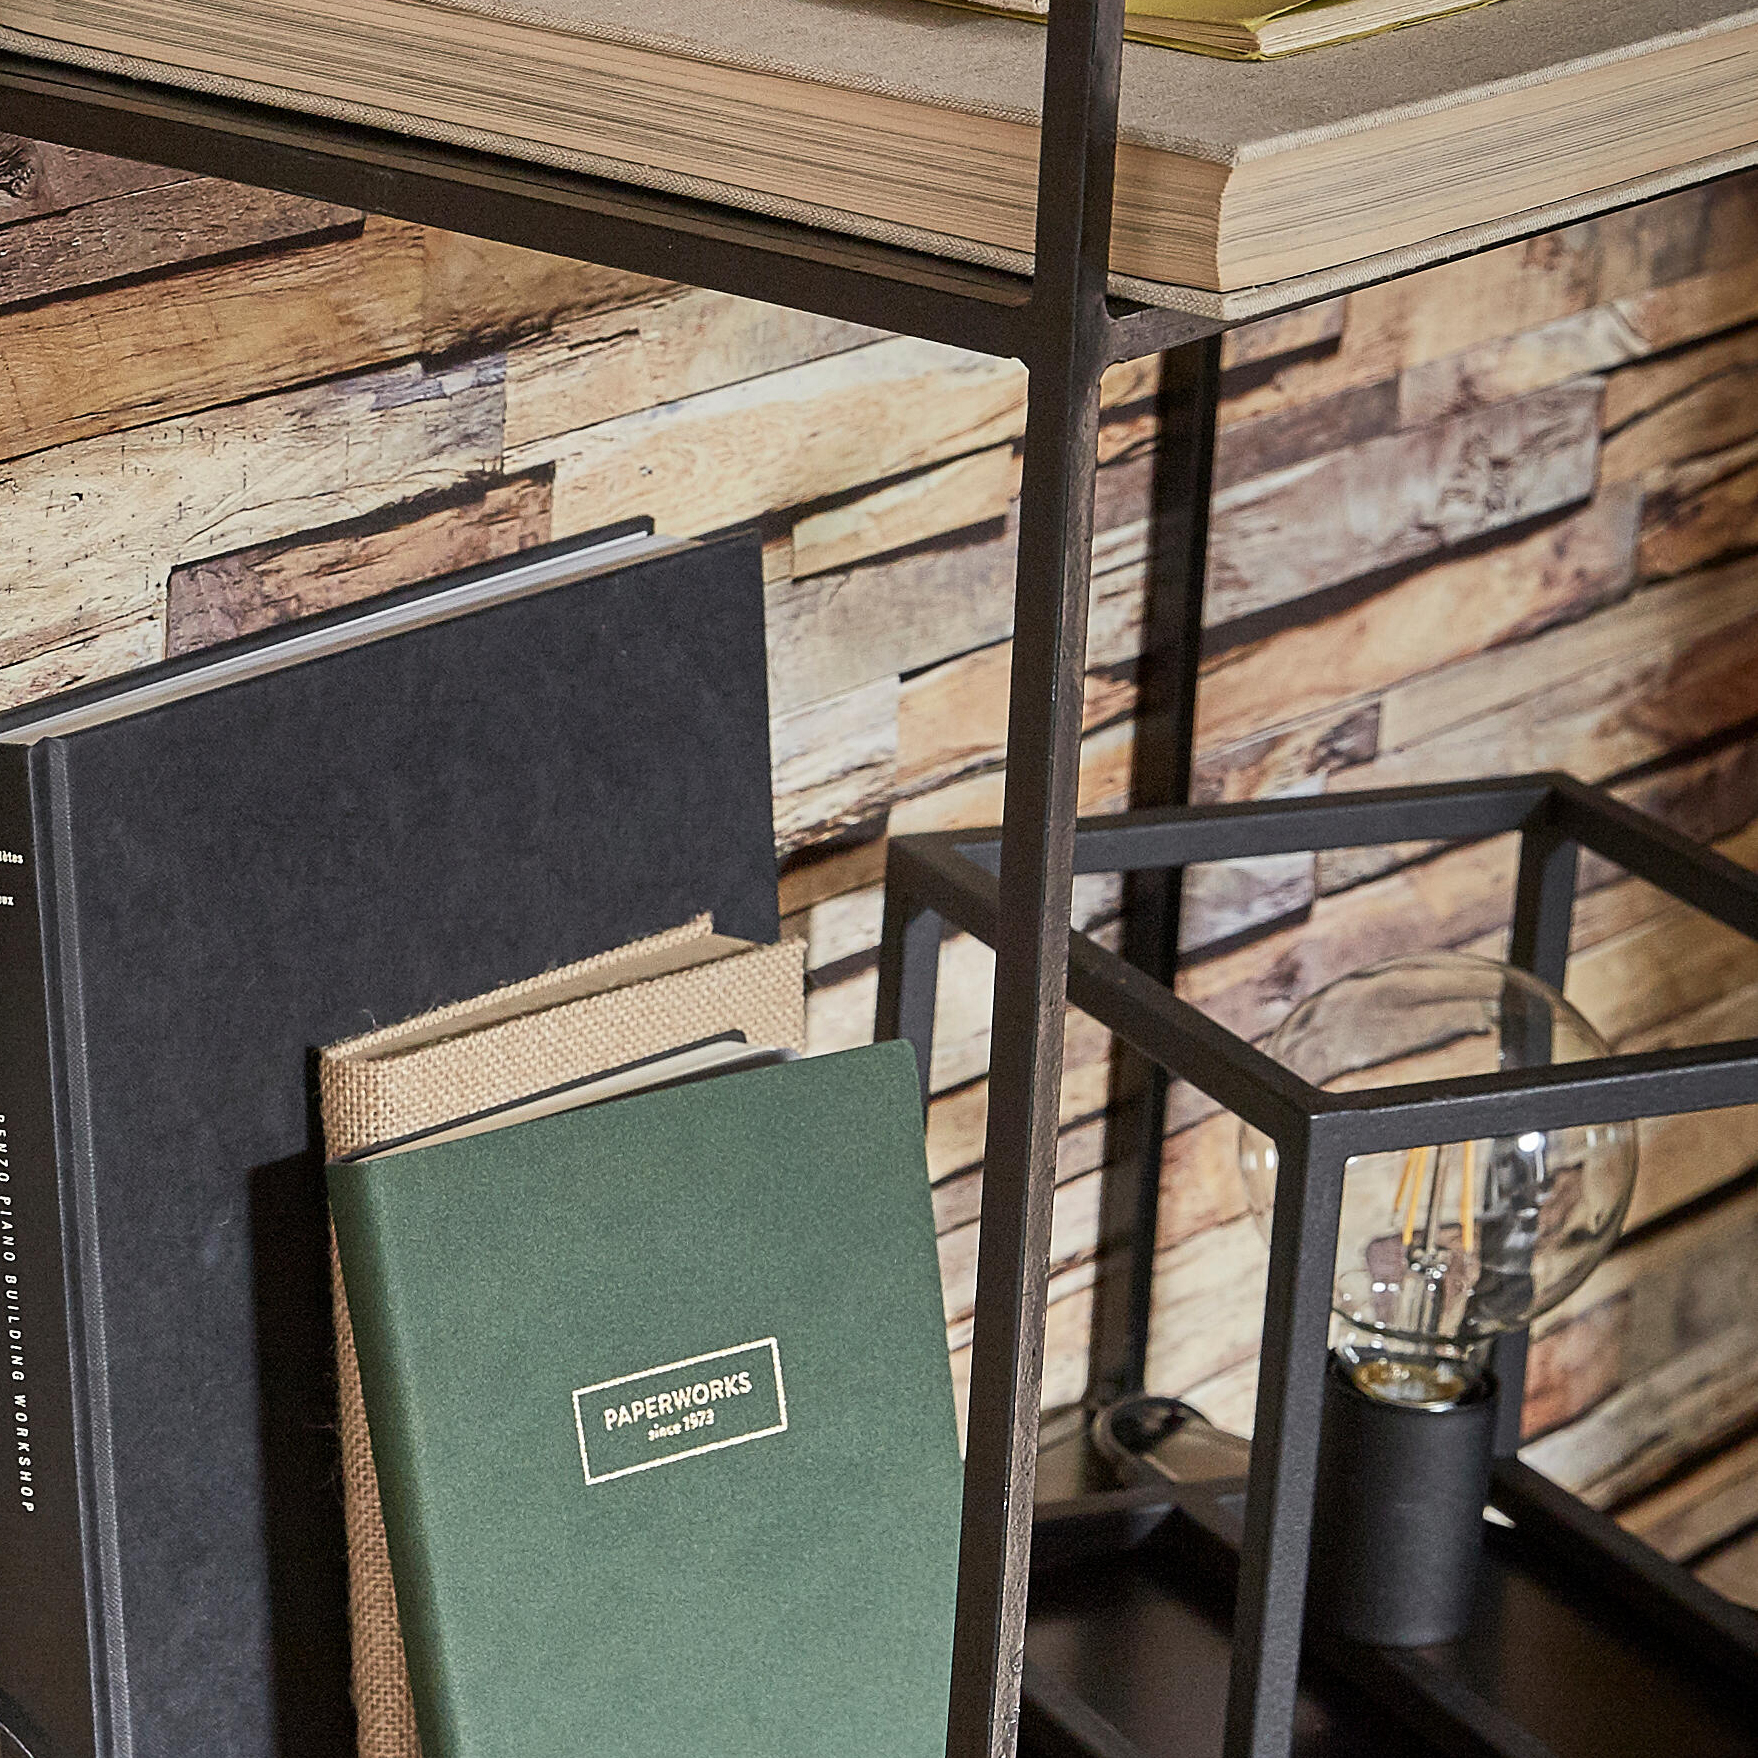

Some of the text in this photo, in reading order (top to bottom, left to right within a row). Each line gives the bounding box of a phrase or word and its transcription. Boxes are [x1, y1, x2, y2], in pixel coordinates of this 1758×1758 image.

[0, 1195, 16, 1262] PIANO
[4, 1274, 25, 1382] BUILDING
[603, 1371, 753, 1432] PAPERWORKS
[647, 1422, 682, 1442] since
[13, 1394, 35, 1513] WORKSHOP
